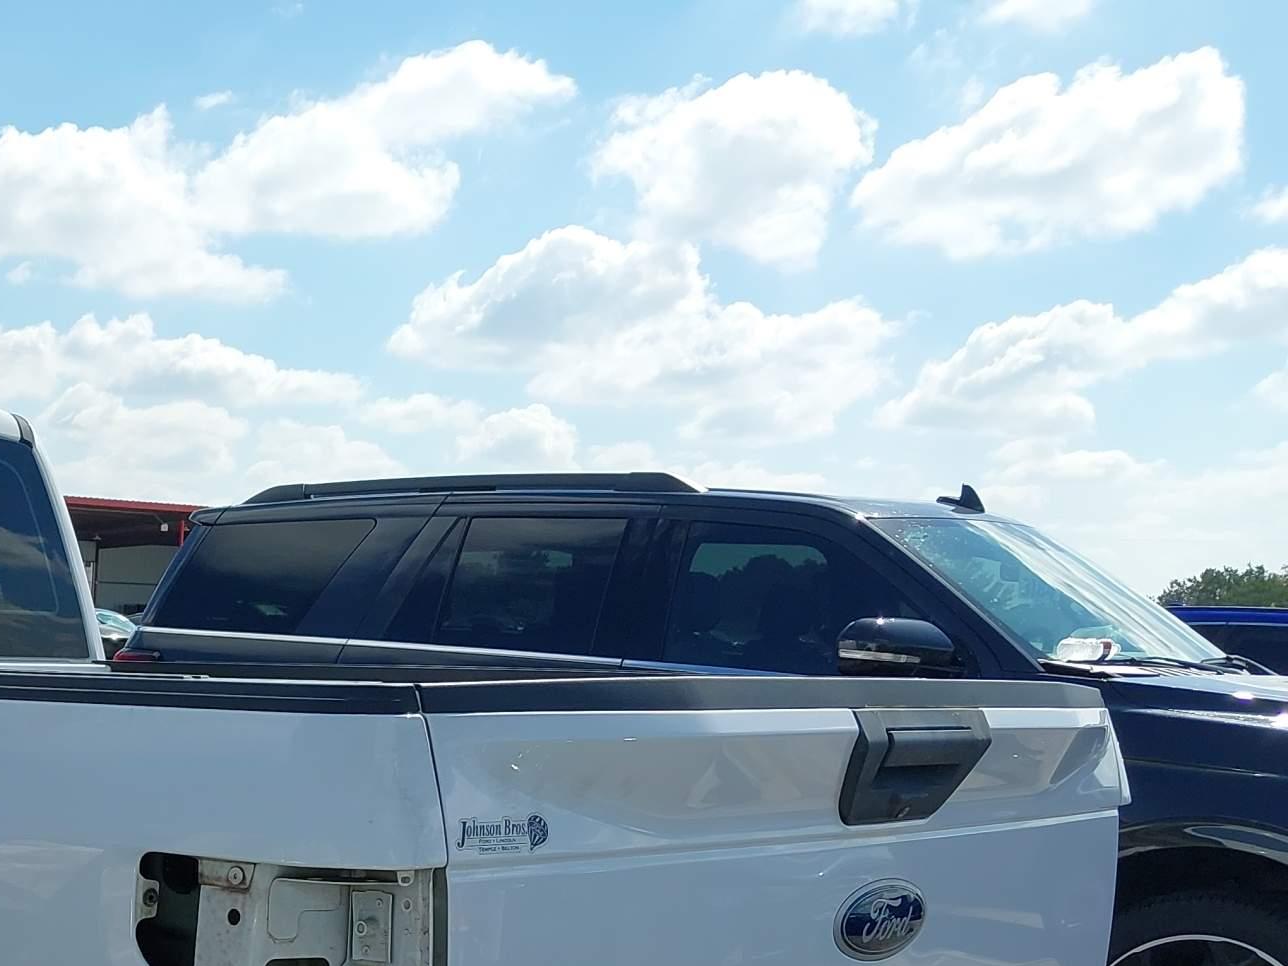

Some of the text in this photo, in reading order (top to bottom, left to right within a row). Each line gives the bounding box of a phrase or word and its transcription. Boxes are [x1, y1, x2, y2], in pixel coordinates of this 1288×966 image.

[457, 819, 528, 848] Johnson Bros.
[862, 898, 915, 944] Ford
